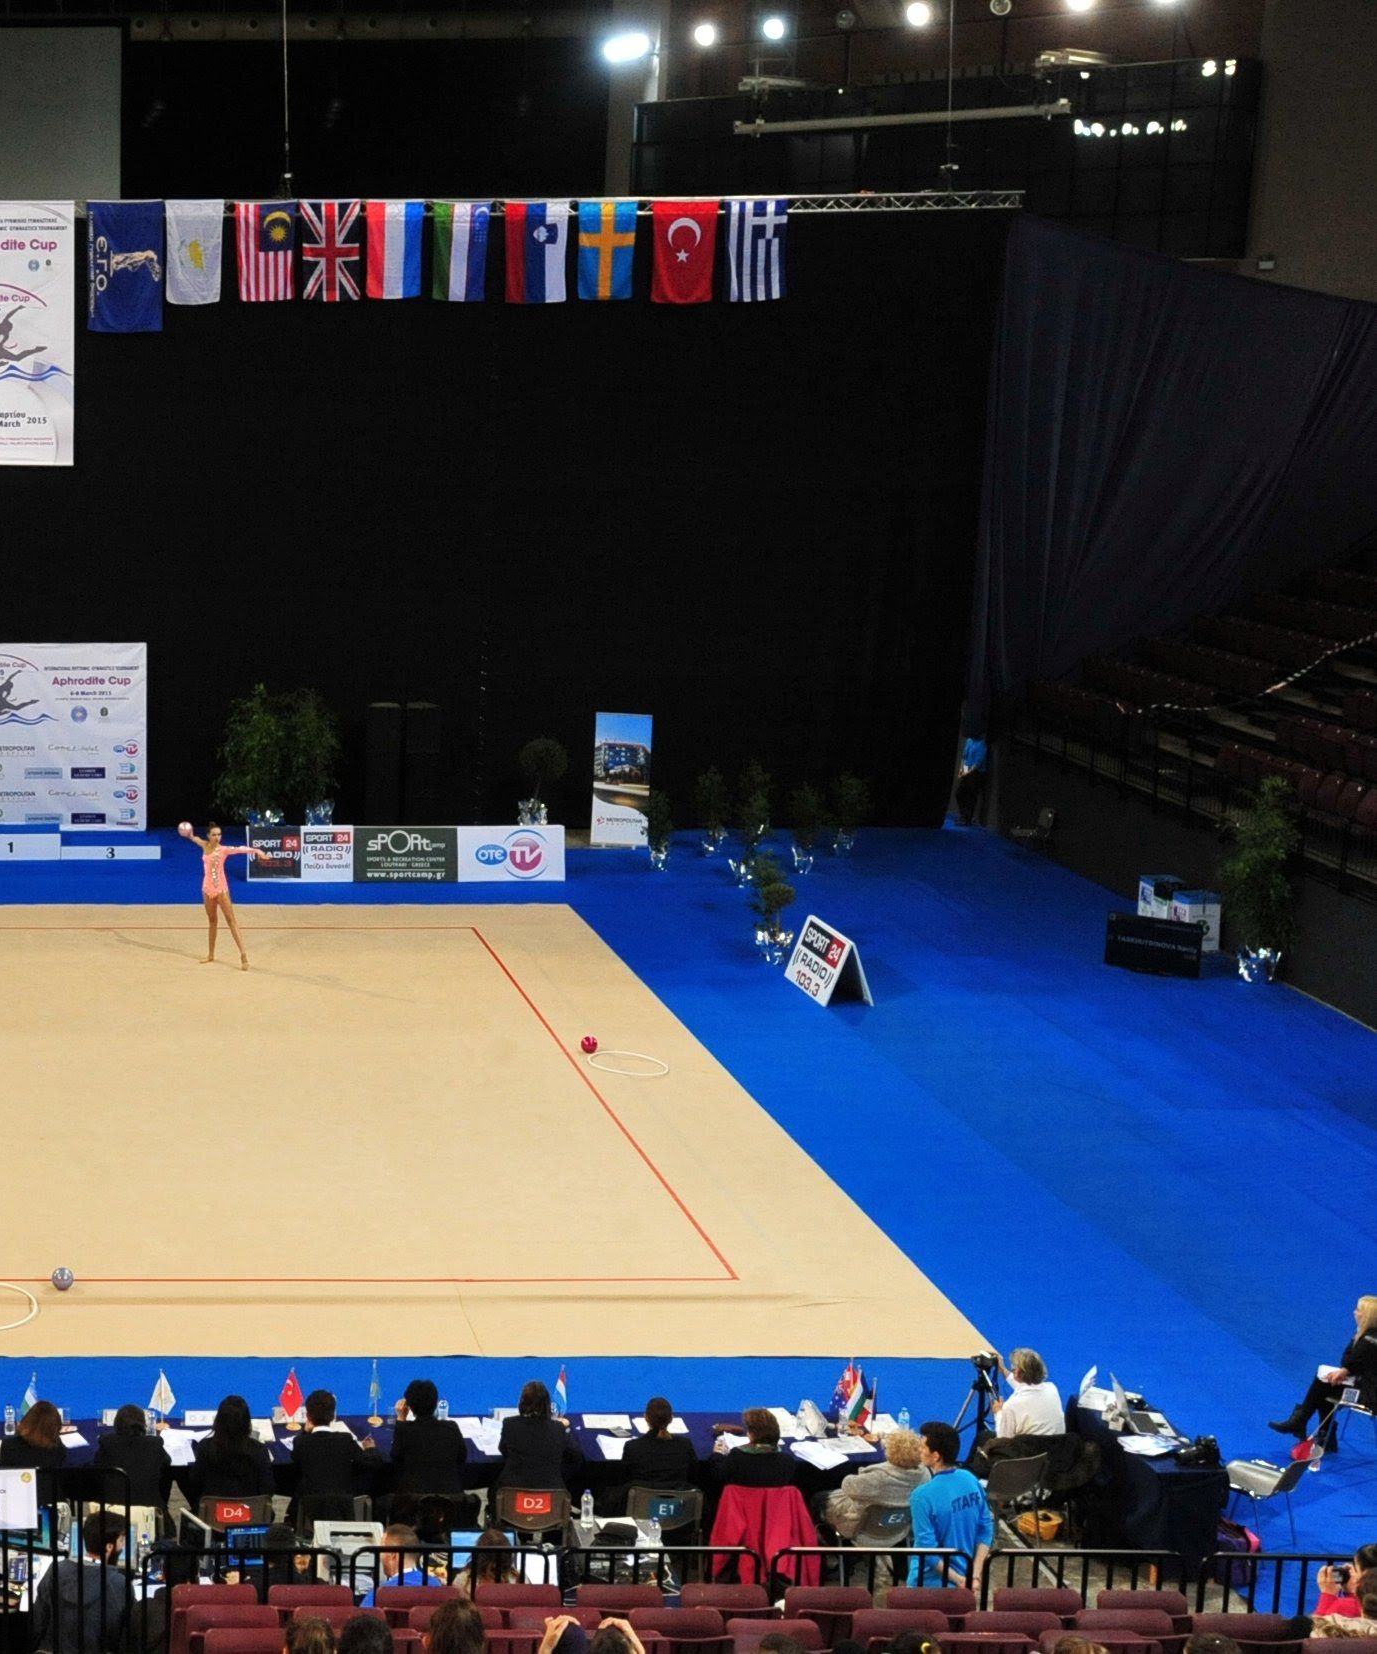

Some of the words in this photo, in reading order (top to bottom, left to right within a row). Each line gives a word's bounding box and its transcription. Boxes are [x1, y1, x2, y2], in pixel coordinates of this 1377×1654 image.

[29, 239, 57, 252] Cup
[11, 294, 30, 303] Cup
[52, 676, 105, 687] Aphrodite
[108, 676, 131, 686] Cup
[252, 839, 281, 848] SPORT
[285, 838, 298, 848] 24
[305, 834, 333, 842] SPORT
[336, 834, 349, 842] 24
[7, 842, 14, 853] 1
[106, 847, 115, 859] 3
[263, 851, 293, 859] ADIO
[311, 853, 343, 861] 103.3
[510, 846, 542, 864] TV
[366, 871, 446, 880] www.sportcamp.gr
[805, 927, 830, 954] SPORT
[828, 944, 841, 962] 24
[801, 952, 828, 980] RADIO
[795, 969, 820, 997] 103.3
[523, 1497, 543, 1509] D2
[951, 1491, 981, 1513] STAFF
[223, 1507, 243, 1518] D4
[658, 1503, 674, 1515] E1
[888, 1513, 905, 1524] E2
